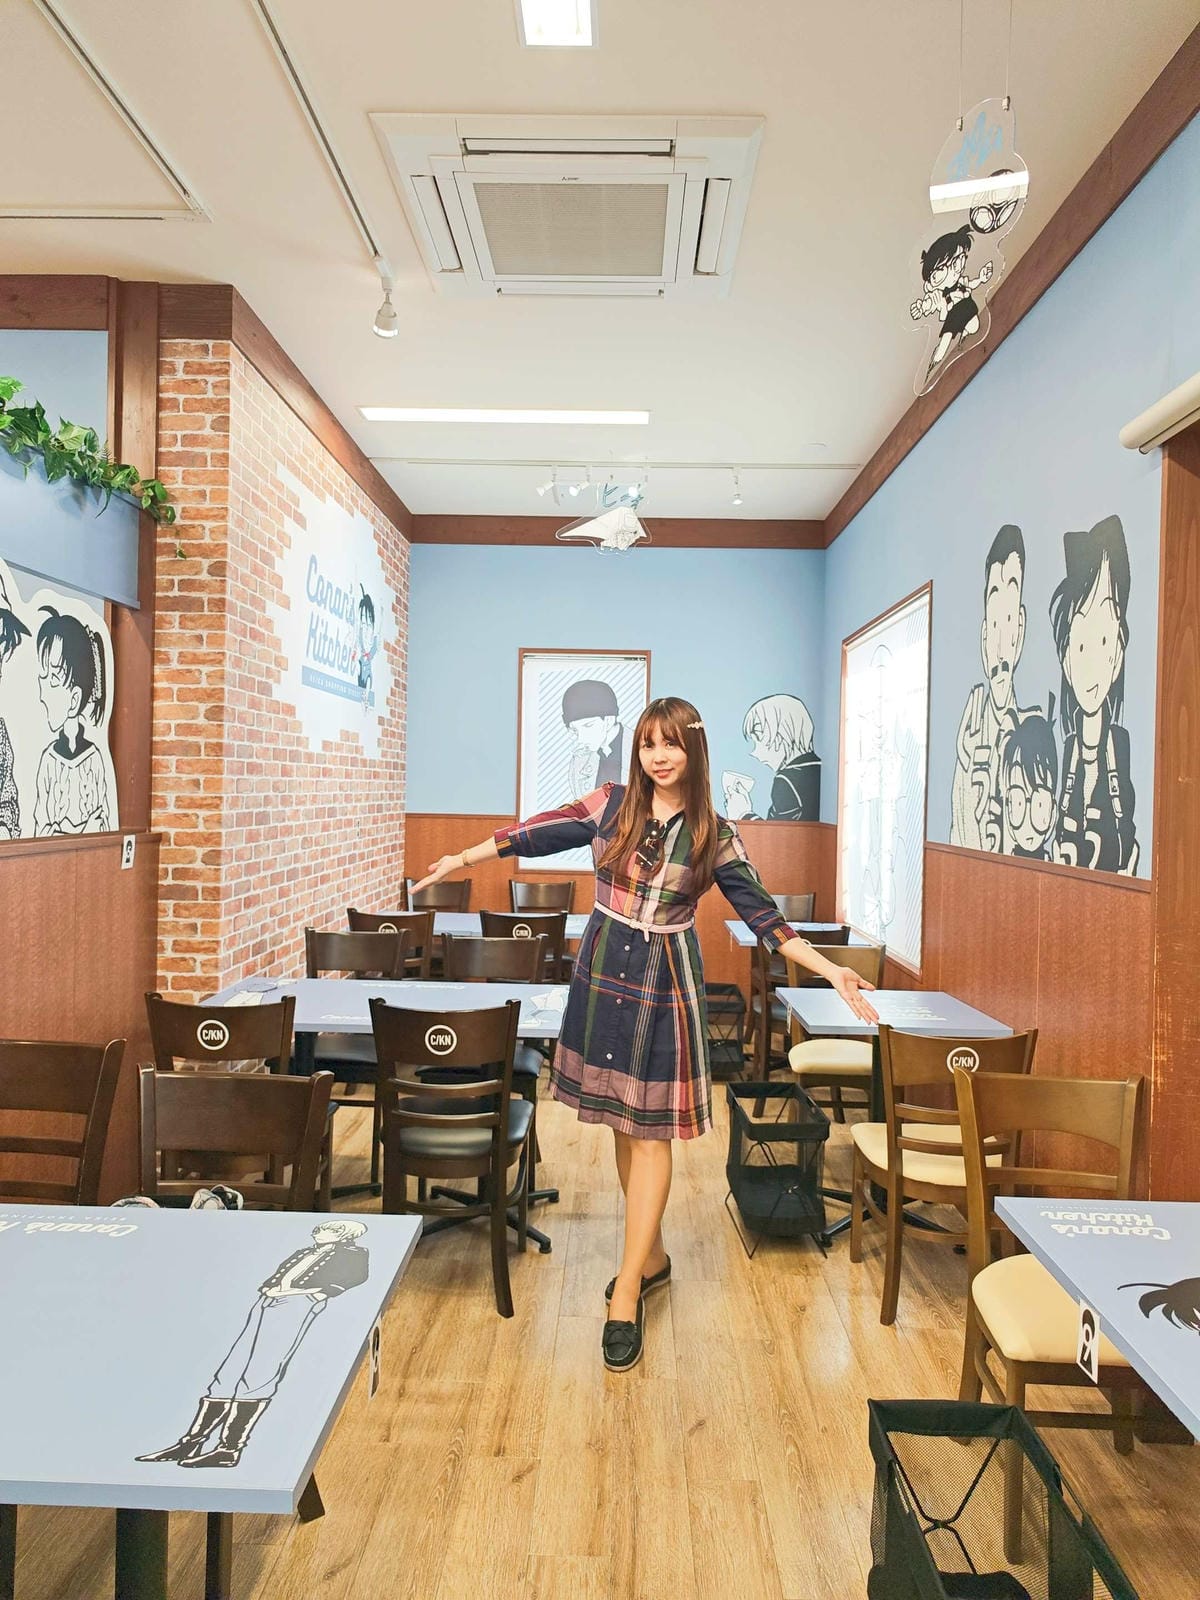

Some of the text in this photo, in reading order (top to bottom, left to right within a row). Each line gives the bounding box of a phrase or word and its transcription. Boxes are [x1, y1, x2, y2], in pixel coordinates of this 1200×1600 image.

[306, 554, 356, 627] Conan's
[430, 1034, 452, 1046] C/KN
[952, 1056, 974, 1068] C/KN
[1040, 1211, 1154, 1226] Kitchen
[24, 1222, 138, 1237] Conan's
[1051, 1224, 1171, 1240] Conan's
